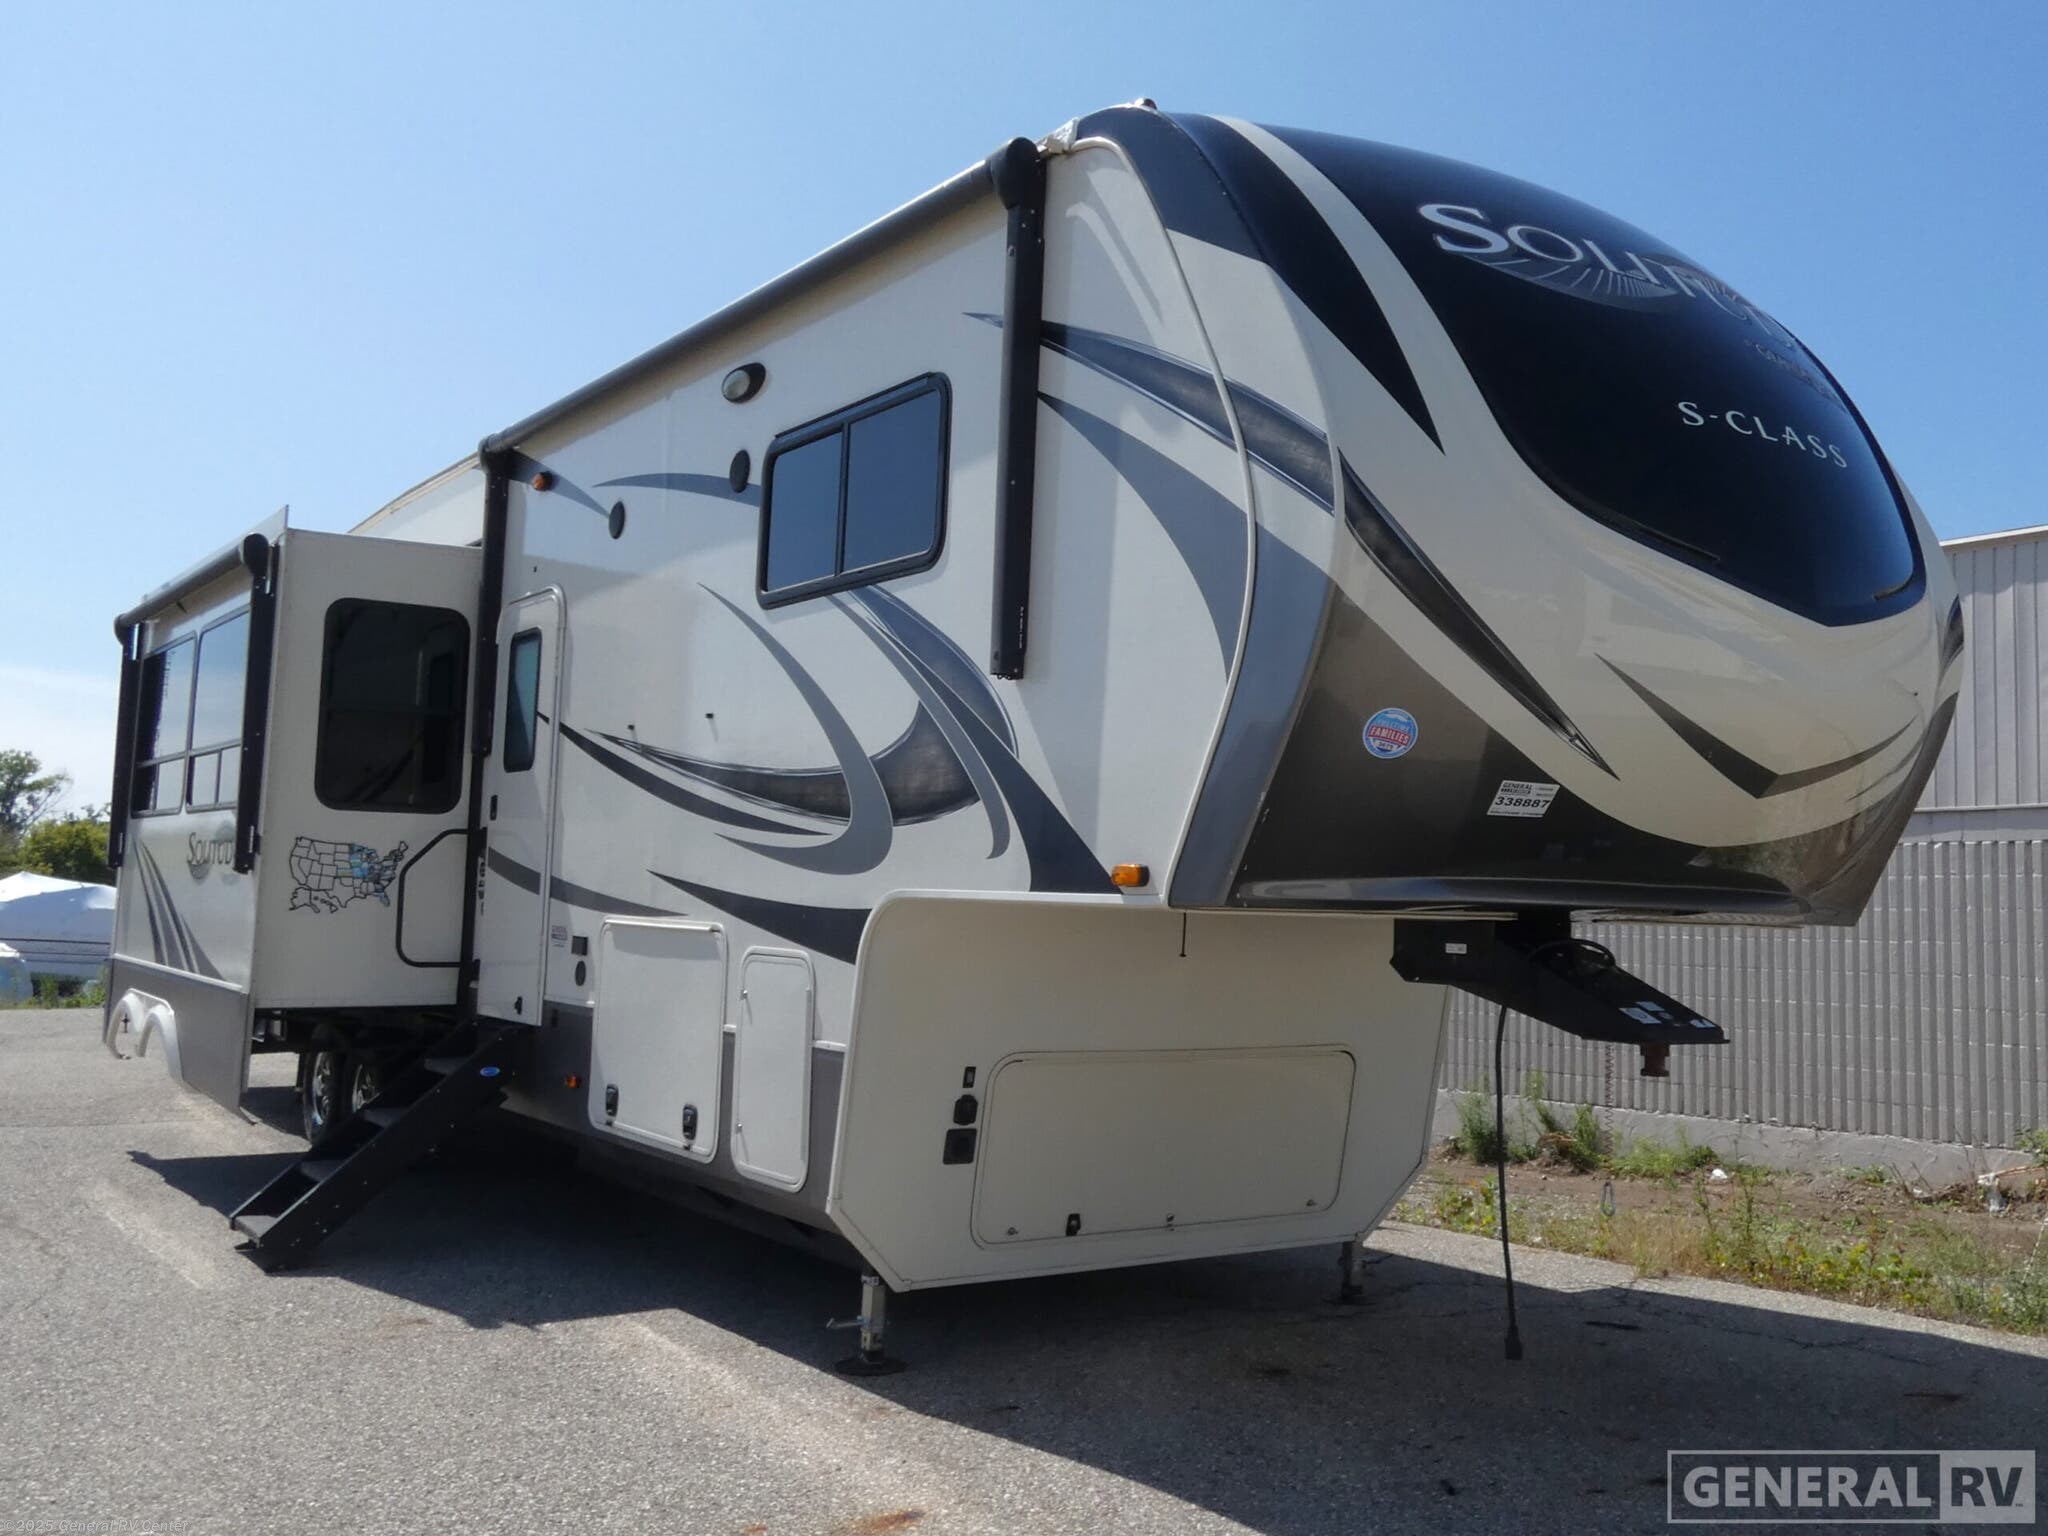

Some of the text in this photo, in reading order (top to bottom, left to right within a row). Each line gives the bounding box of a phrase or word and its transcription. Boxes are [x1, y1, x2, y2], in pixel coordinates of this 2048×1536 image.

[1678, 400, 1848, 469] S-CLASS
[1370, 725, 1410, 746] FAMILIES
[1494, 796, 1551, 809] 338887
